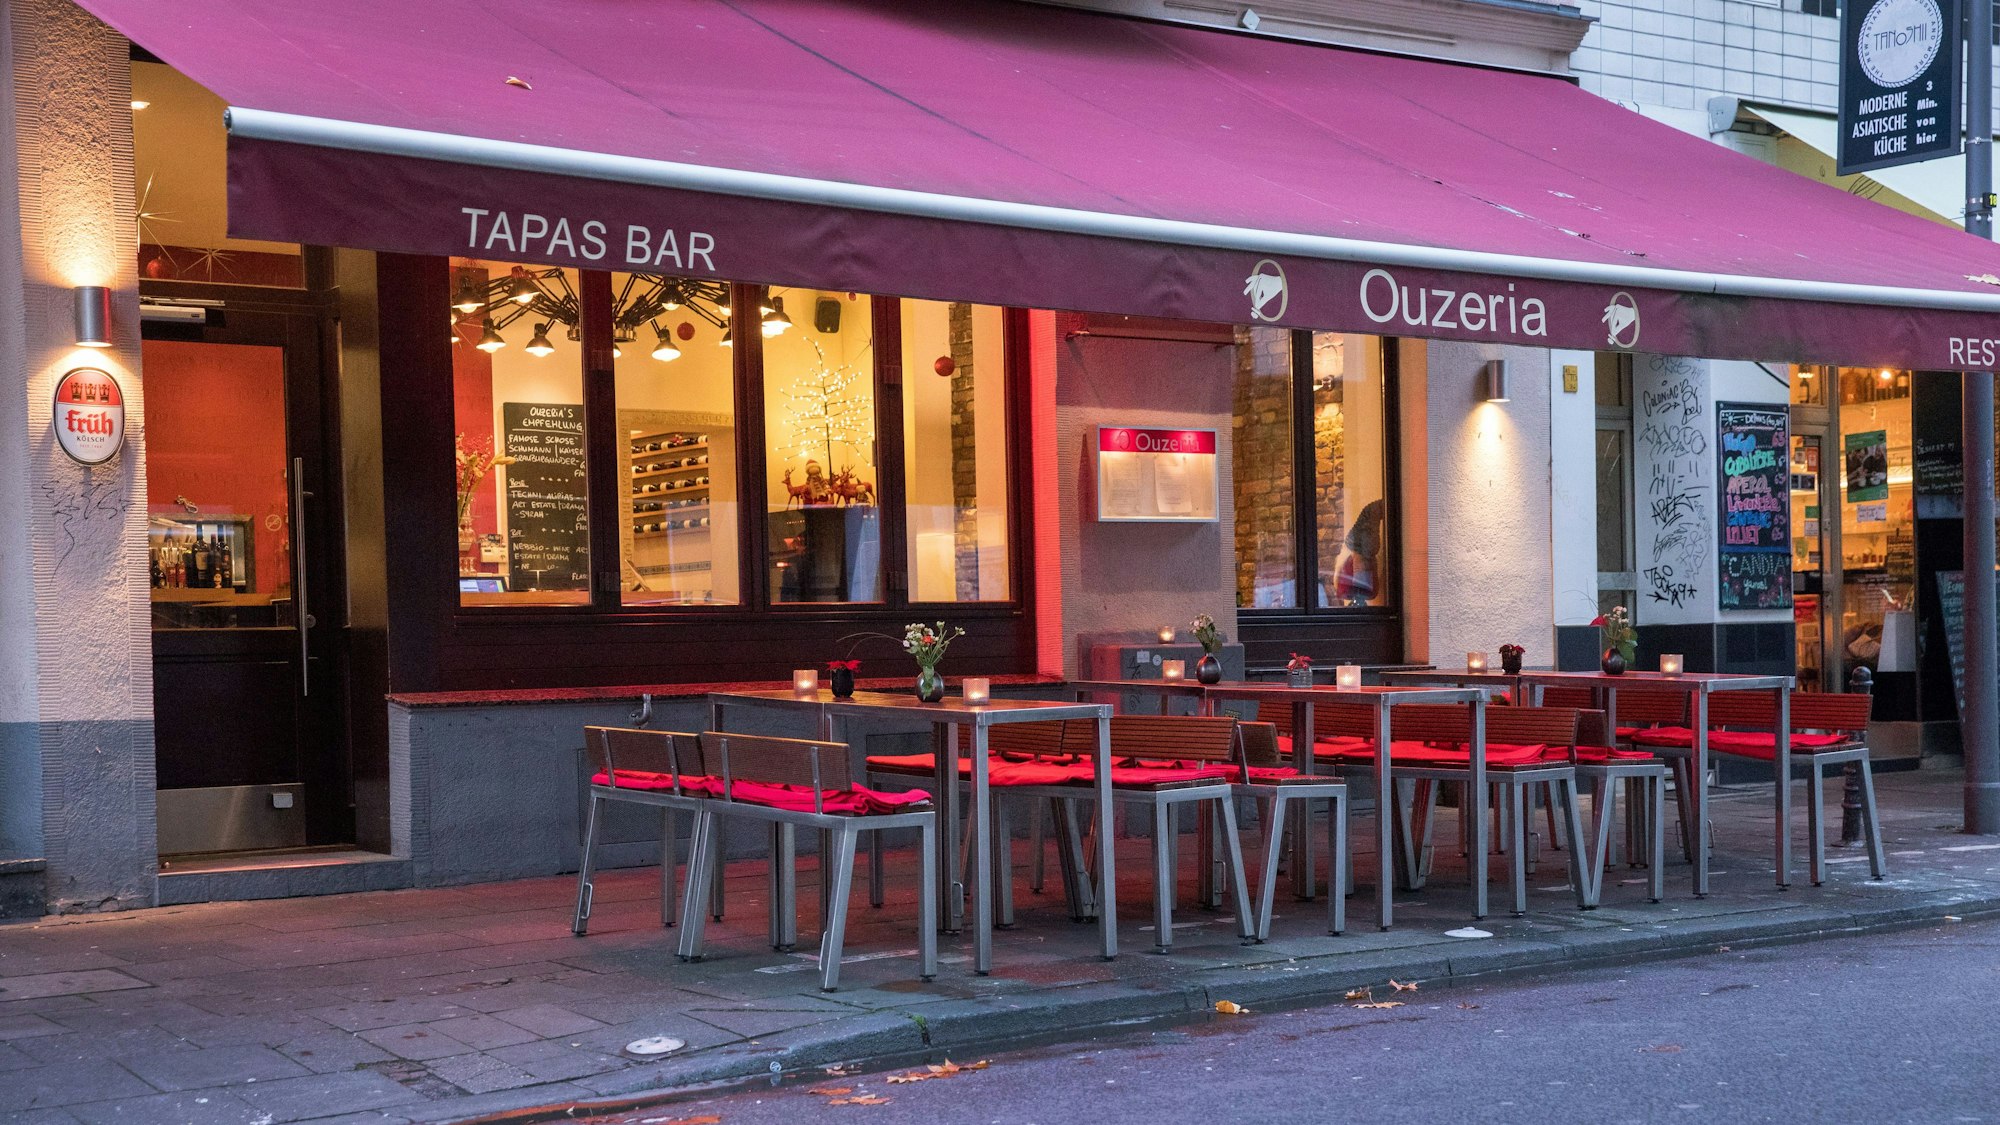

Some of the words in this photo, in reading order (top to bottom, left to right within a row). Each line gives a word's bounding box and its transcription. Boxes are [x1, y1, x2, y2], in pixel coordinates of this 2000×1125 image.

[1874, 23, 1927, 51] TANOSHII
[1926, 81, 1933, 91] 3
[1859, 91, 1908, 115] MODERNE
[1917, 98, 1938, 110] Min.
[1852, 114, 1907, 138] ASIATISCHE
[1916, 117, 1936, 127] von
[1874, 136, 1907, 156] KÜCHE
[1916, 133, 1937, 145] hier
[461, 207, 607, 260] TAPAS
[626, 224, 716, 271] BAR
[1360, 268, 1548, 337] Ouzeria
[65, 409, 113, 437] früh
[1135, 432, 1200, 451] Ouzeria
[1729, 554, 1786, 577] CANDIA
